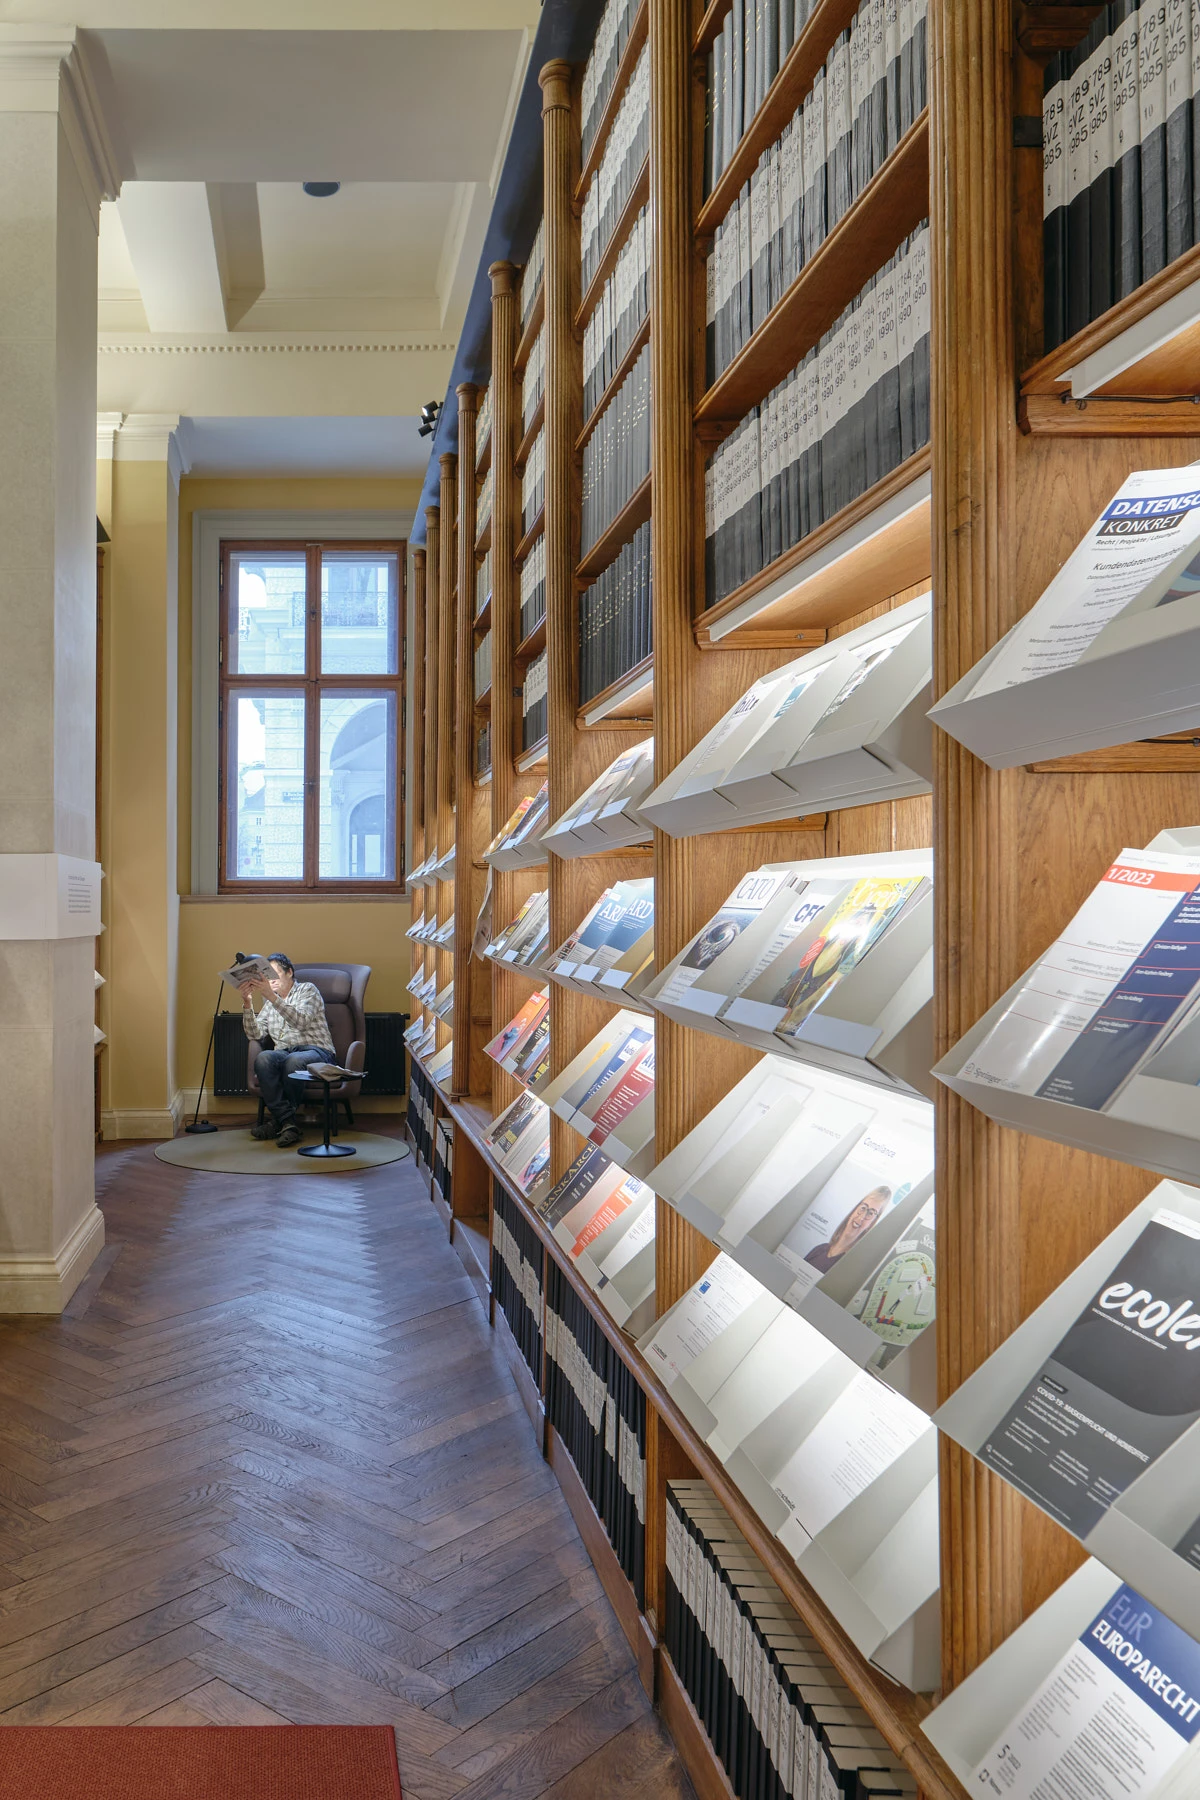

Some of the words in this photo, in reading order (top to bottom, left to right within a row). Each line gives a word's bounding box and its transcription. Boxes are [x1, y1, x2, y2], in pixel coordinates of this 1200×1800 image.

[1139, 7, 1166, 40] 789
[1113, 32, 1138, 64] 789
[1140, 34, 1160, 68] SVZ
[1167, 35, 1186, 68] 985
[1089, 57, 1112, 88] 789
[1113, 59, 1132, 91] SVZ
[1068, 79, 1089, 109] 789
[1089, 83, 1106, 114] SVZ
[1068, 104, 1084, 135] SVZ
[1044, 142, 1062, 171] 985
[879, 319, 895, 340] 1990
[1104, 514, 1184, 533] KONKRET
[1119, 537, 1145, 546] Projekte
[737, 878, 776, 899] CATO
[1108, 868, 1155, 885] 1/2023
[625, 899, 655, 918] ARD
[974, 1068, 1002, 1083] Springer
[863, 1137, 897, 1158] Compliance
[1099, 1282, 1200, 1351] ecole
[1037, 1386, 1065, 1407] COVID-19:
[1092, 1619, 1200, 1724] EUROPARECHT
